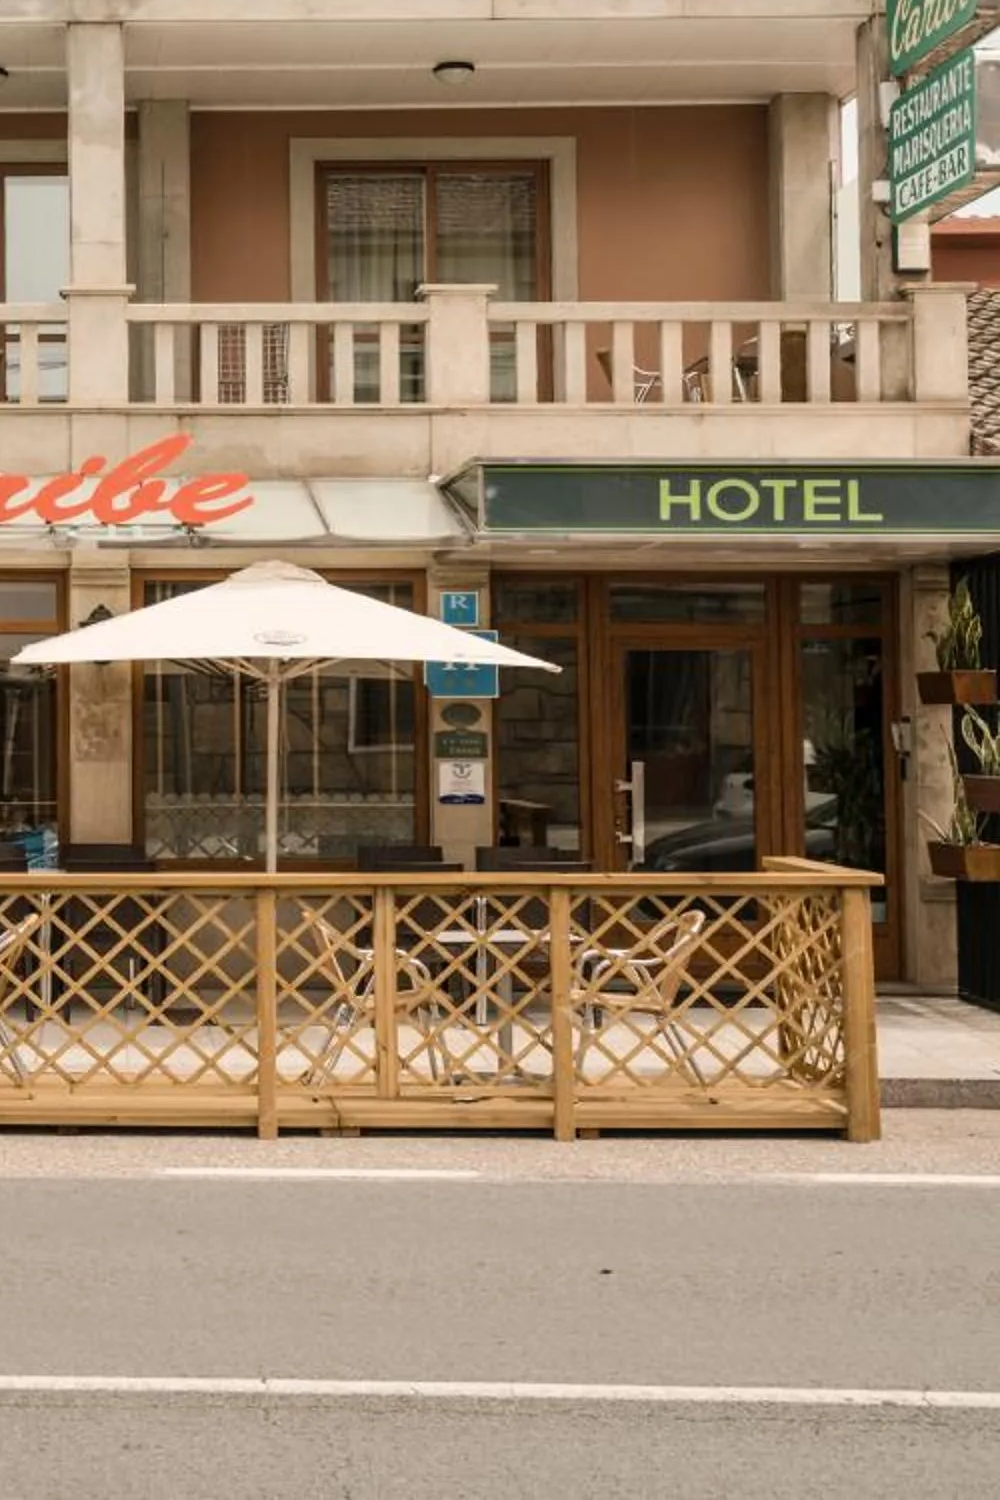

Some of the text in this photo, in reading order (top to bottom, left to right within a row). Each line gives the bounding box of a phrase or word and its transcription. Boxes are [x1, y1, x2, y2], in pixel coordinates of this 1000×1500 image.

[893, 56, 972, 140] RESTAURANTE
[899, 146, 967, 208] CAFE-BAR
[659, 478, 884, 522] HOTEL
[450, 595, 469, 609] R
